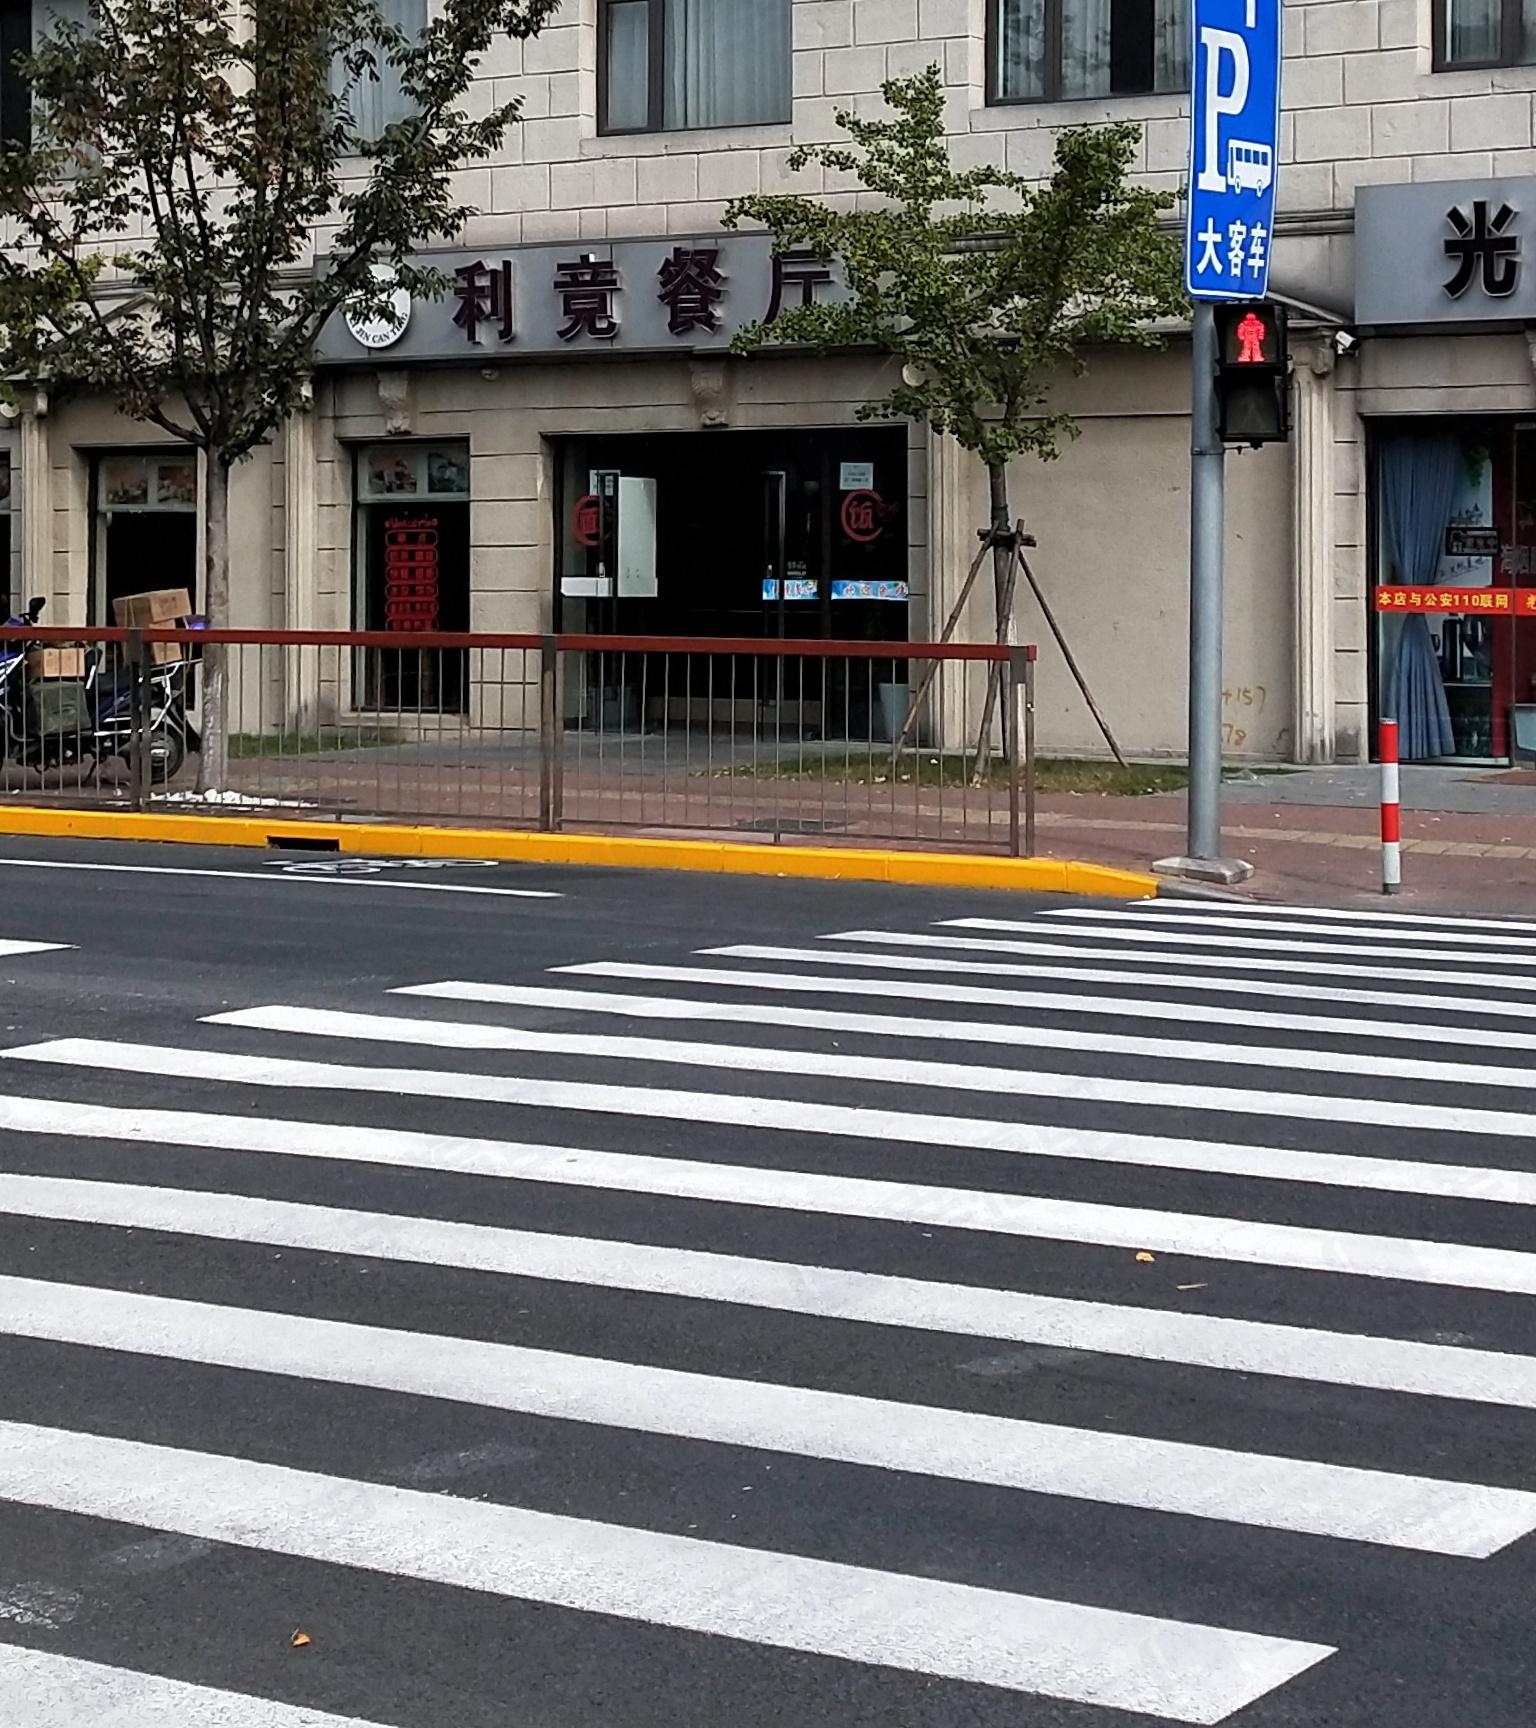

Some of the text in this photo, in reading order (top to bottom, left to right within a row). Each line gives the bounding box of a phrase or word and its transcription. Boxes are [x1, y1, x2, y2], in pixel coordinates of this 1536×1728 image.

[1198, 26, 1250, 194] P
[1196, 217, 1267, 280] 大客车
[1378, 592, 1509, 610] 本店与公安110联网
